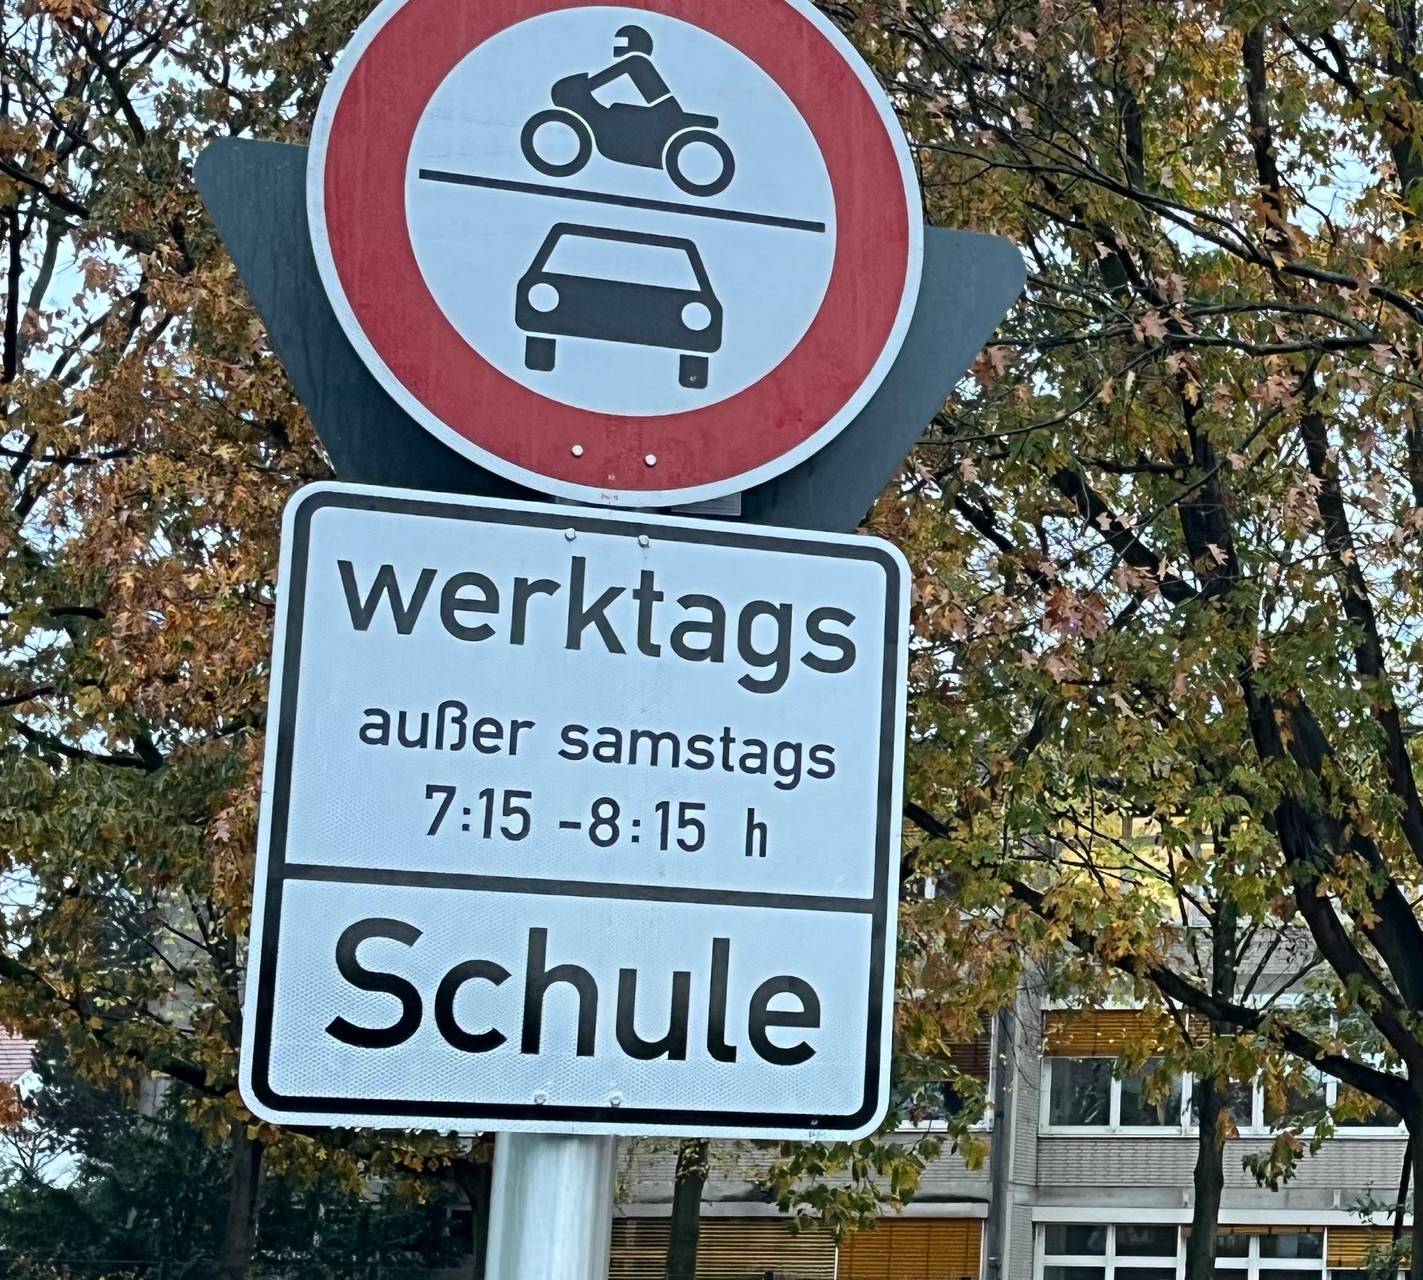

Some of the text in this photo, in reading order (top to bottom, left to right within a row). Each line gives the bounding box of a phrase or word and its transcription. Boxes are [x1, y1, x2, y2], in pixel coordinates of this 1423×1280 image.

[336, 555, 857, 694] werktags
[358, 699, 836, 791] außer samstags
[425, 783, 532, 842] 7:15
[745, 807, 768, 858] h
[325, 917, 821, 1067] Schule
